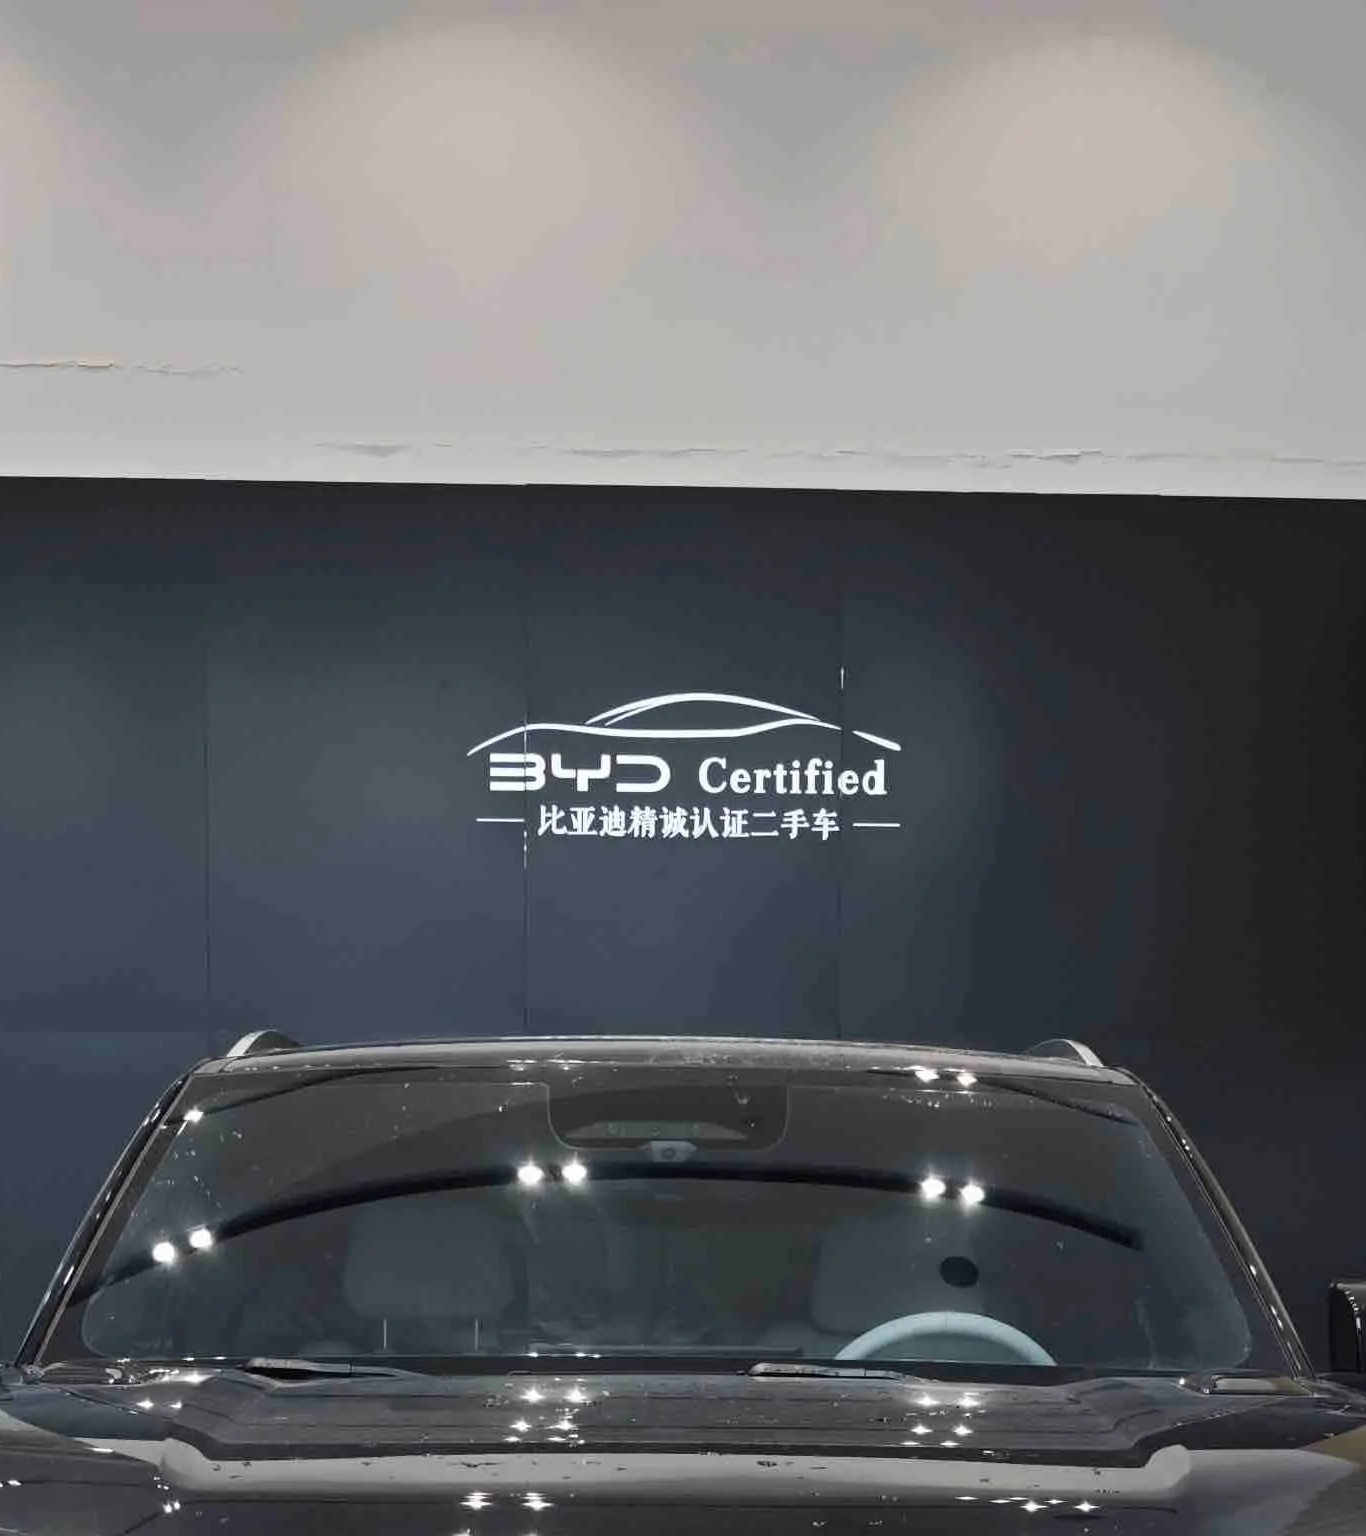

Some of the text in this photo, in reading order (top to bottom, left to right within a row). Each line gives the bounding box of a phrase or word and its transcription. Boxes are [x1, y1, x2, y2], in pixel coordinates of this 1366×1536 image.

[489, 752, 888, 796] BYD Certified
[537, 803, 841, 841] 比亚迪精诚认证二手车
